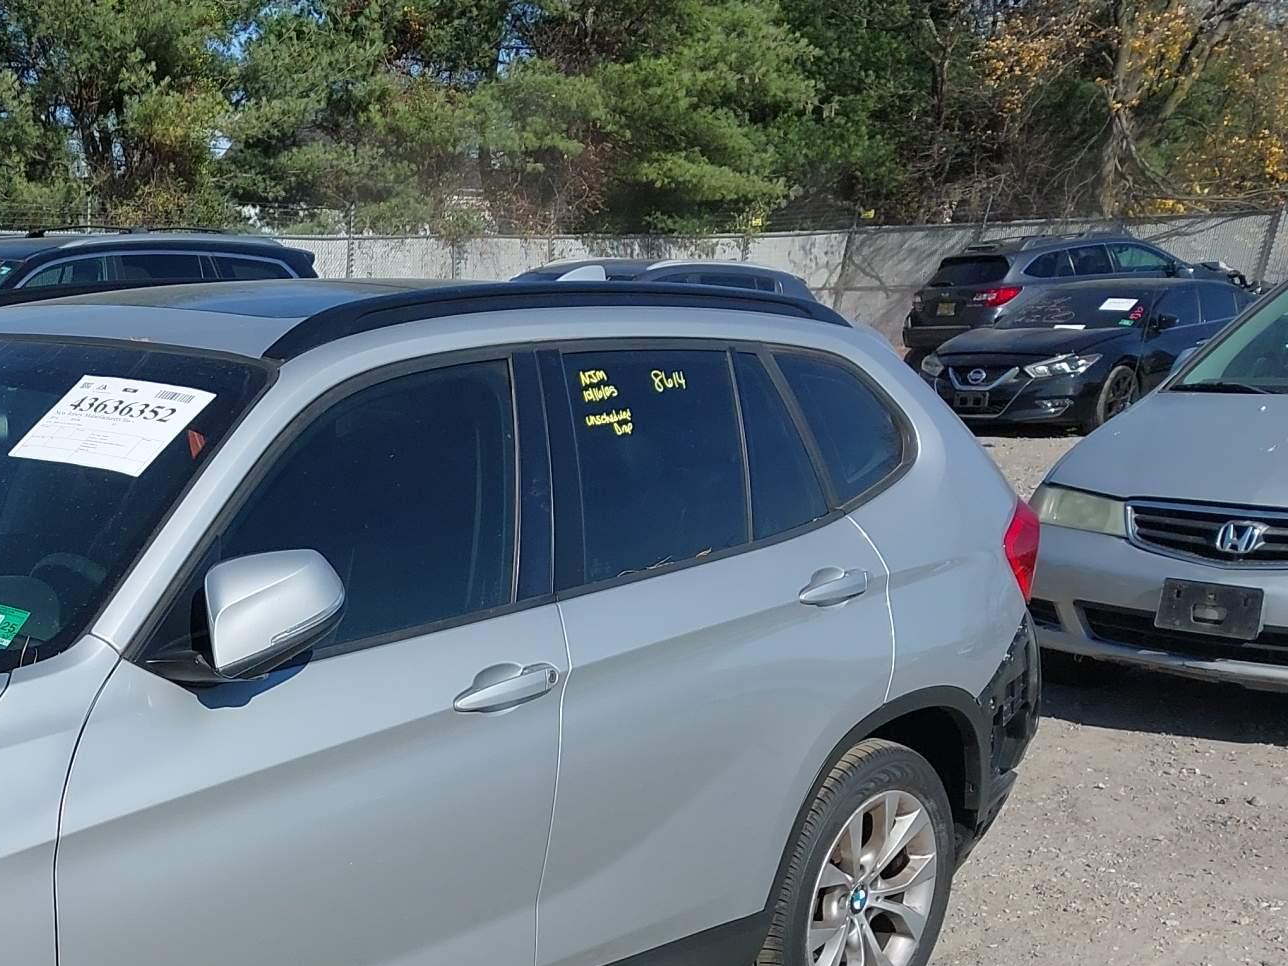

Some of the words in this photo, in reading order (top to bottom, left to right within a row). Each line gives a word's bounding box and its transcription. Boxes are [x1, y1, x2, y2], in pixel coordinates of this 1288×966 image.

[650, 369, 686, 393] 8614
[70, 395, 177, 422] 43636352
[0, 621, 18, 633] 25
